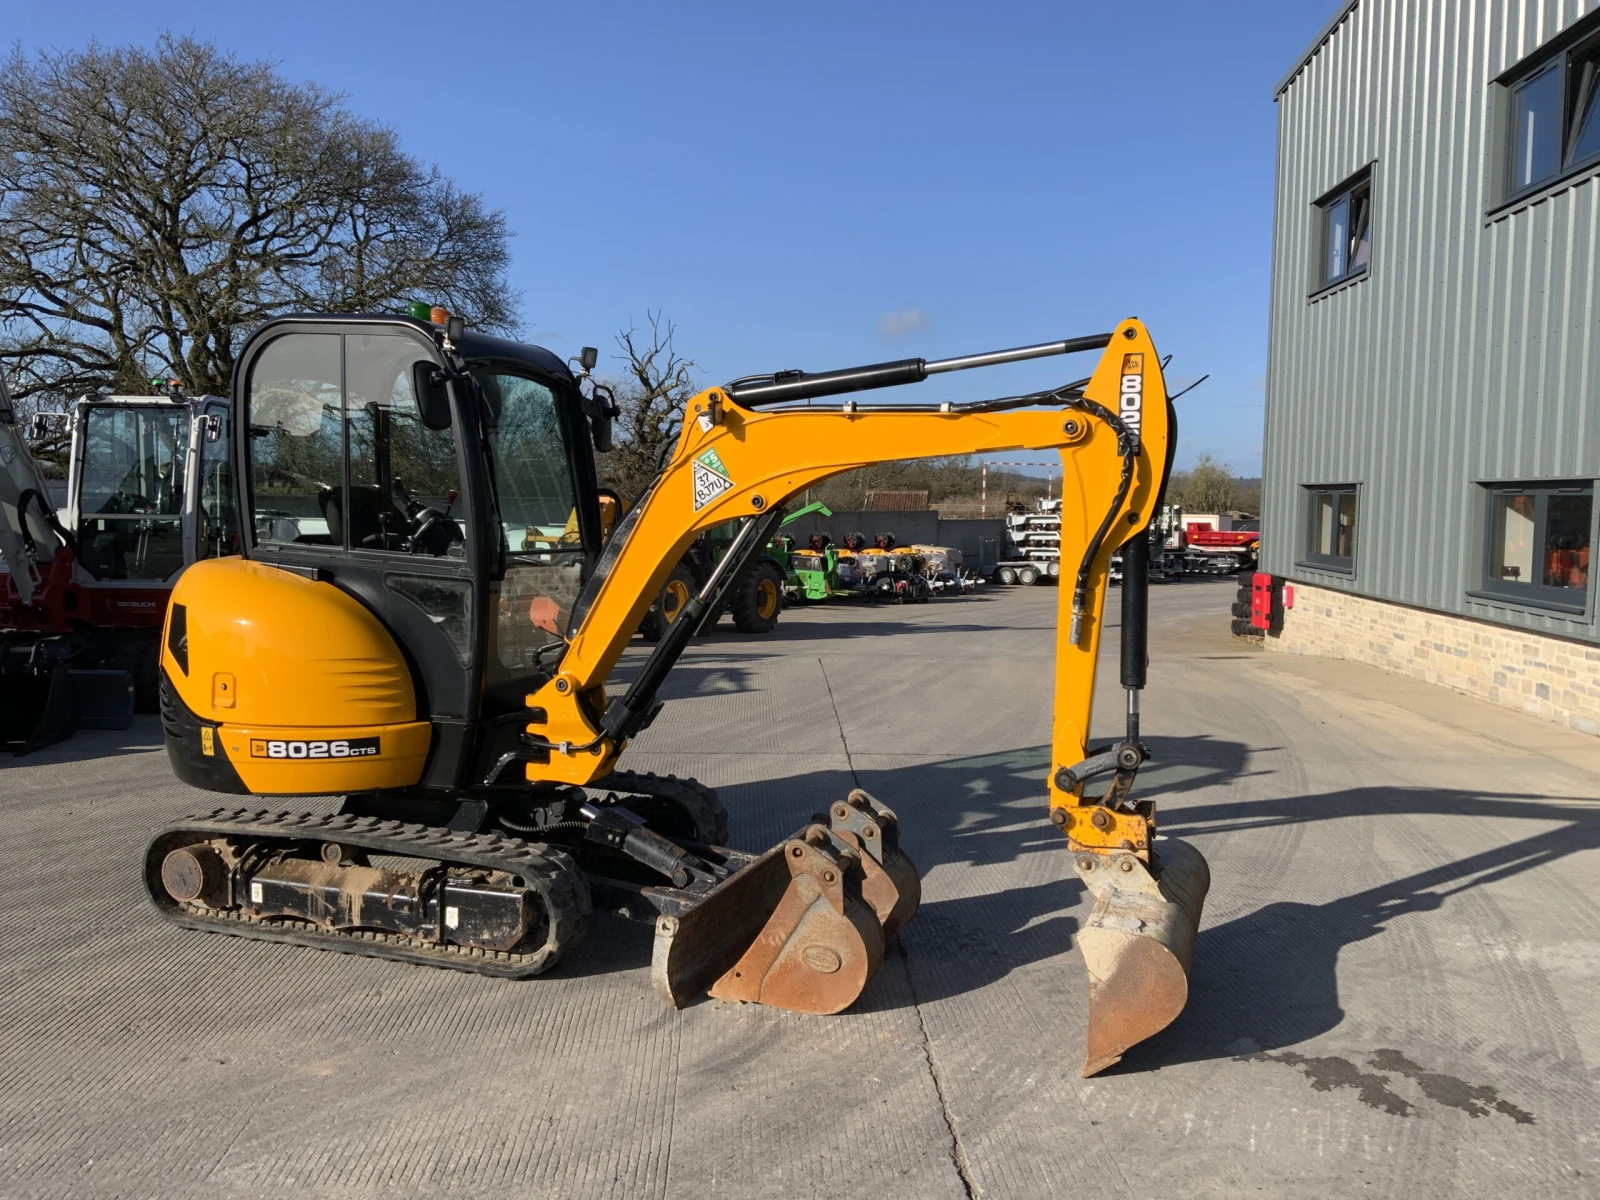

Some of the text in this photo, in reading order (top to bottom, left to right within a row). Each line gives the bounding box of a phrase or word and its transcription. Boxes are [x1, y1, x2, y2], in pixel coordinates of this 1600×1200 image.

[710, 453, 718, 463] 5
[697, 472, 710, 487] 37
[697, 478, 723, 500] BJ7U
[268, 741, 350, 758] 8026
[350, 747, 376, 756] CTS
